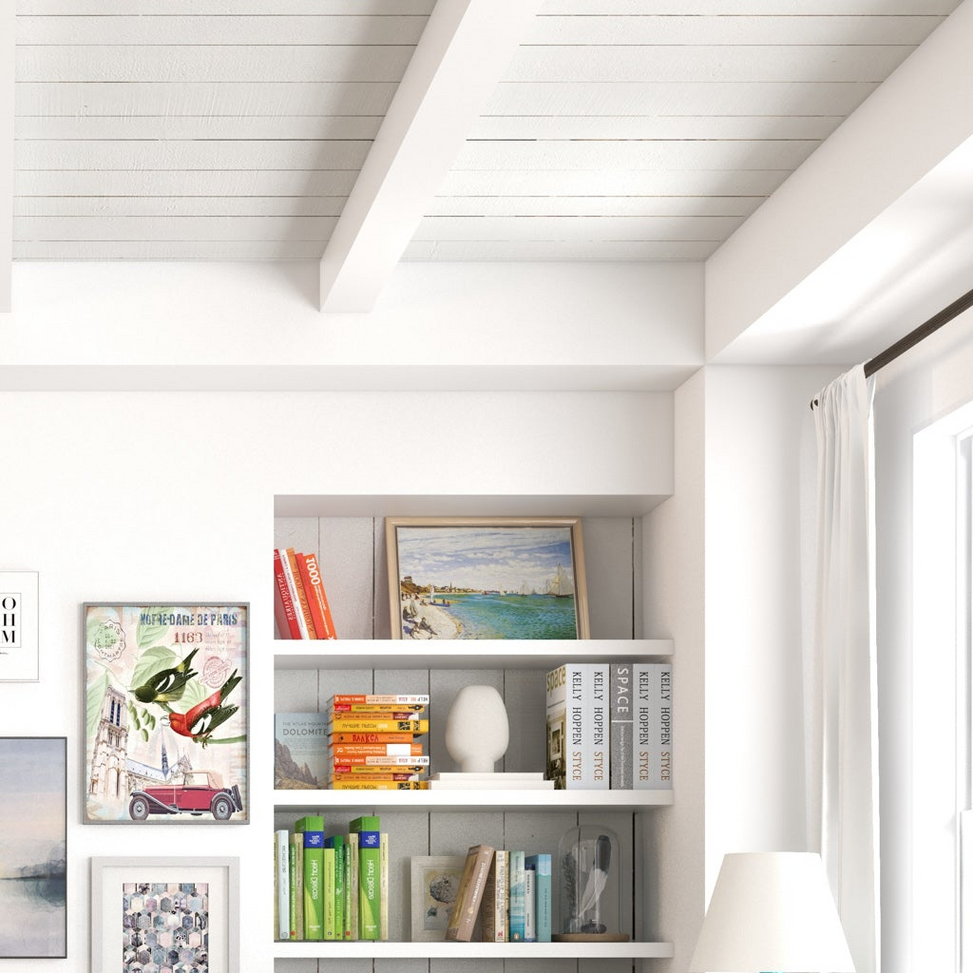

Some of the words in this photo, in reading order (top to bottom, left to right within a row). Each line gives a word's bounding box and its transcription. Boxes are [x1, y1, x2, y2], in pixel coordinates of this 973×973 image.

[197, 613, 208, 626] DE
[210, 613, 238, 626] PARIS
[174, 631, 203, 643] 1163
[572, 671, 582, 701] KELLY
[594, 671, 603, 701] KELLY
[617, 667, 629, 713] SPACE
[639, 671, 649, 701] KELLY
[661, 671, 670, 701] KELLY
[572, 707, 582, 745] HOPPEN
[594, 707, 603, 745] HOPPEN
[639, 707, 649, 745] HOPPEN
[661, 707, 670, 745] HOPPEN
